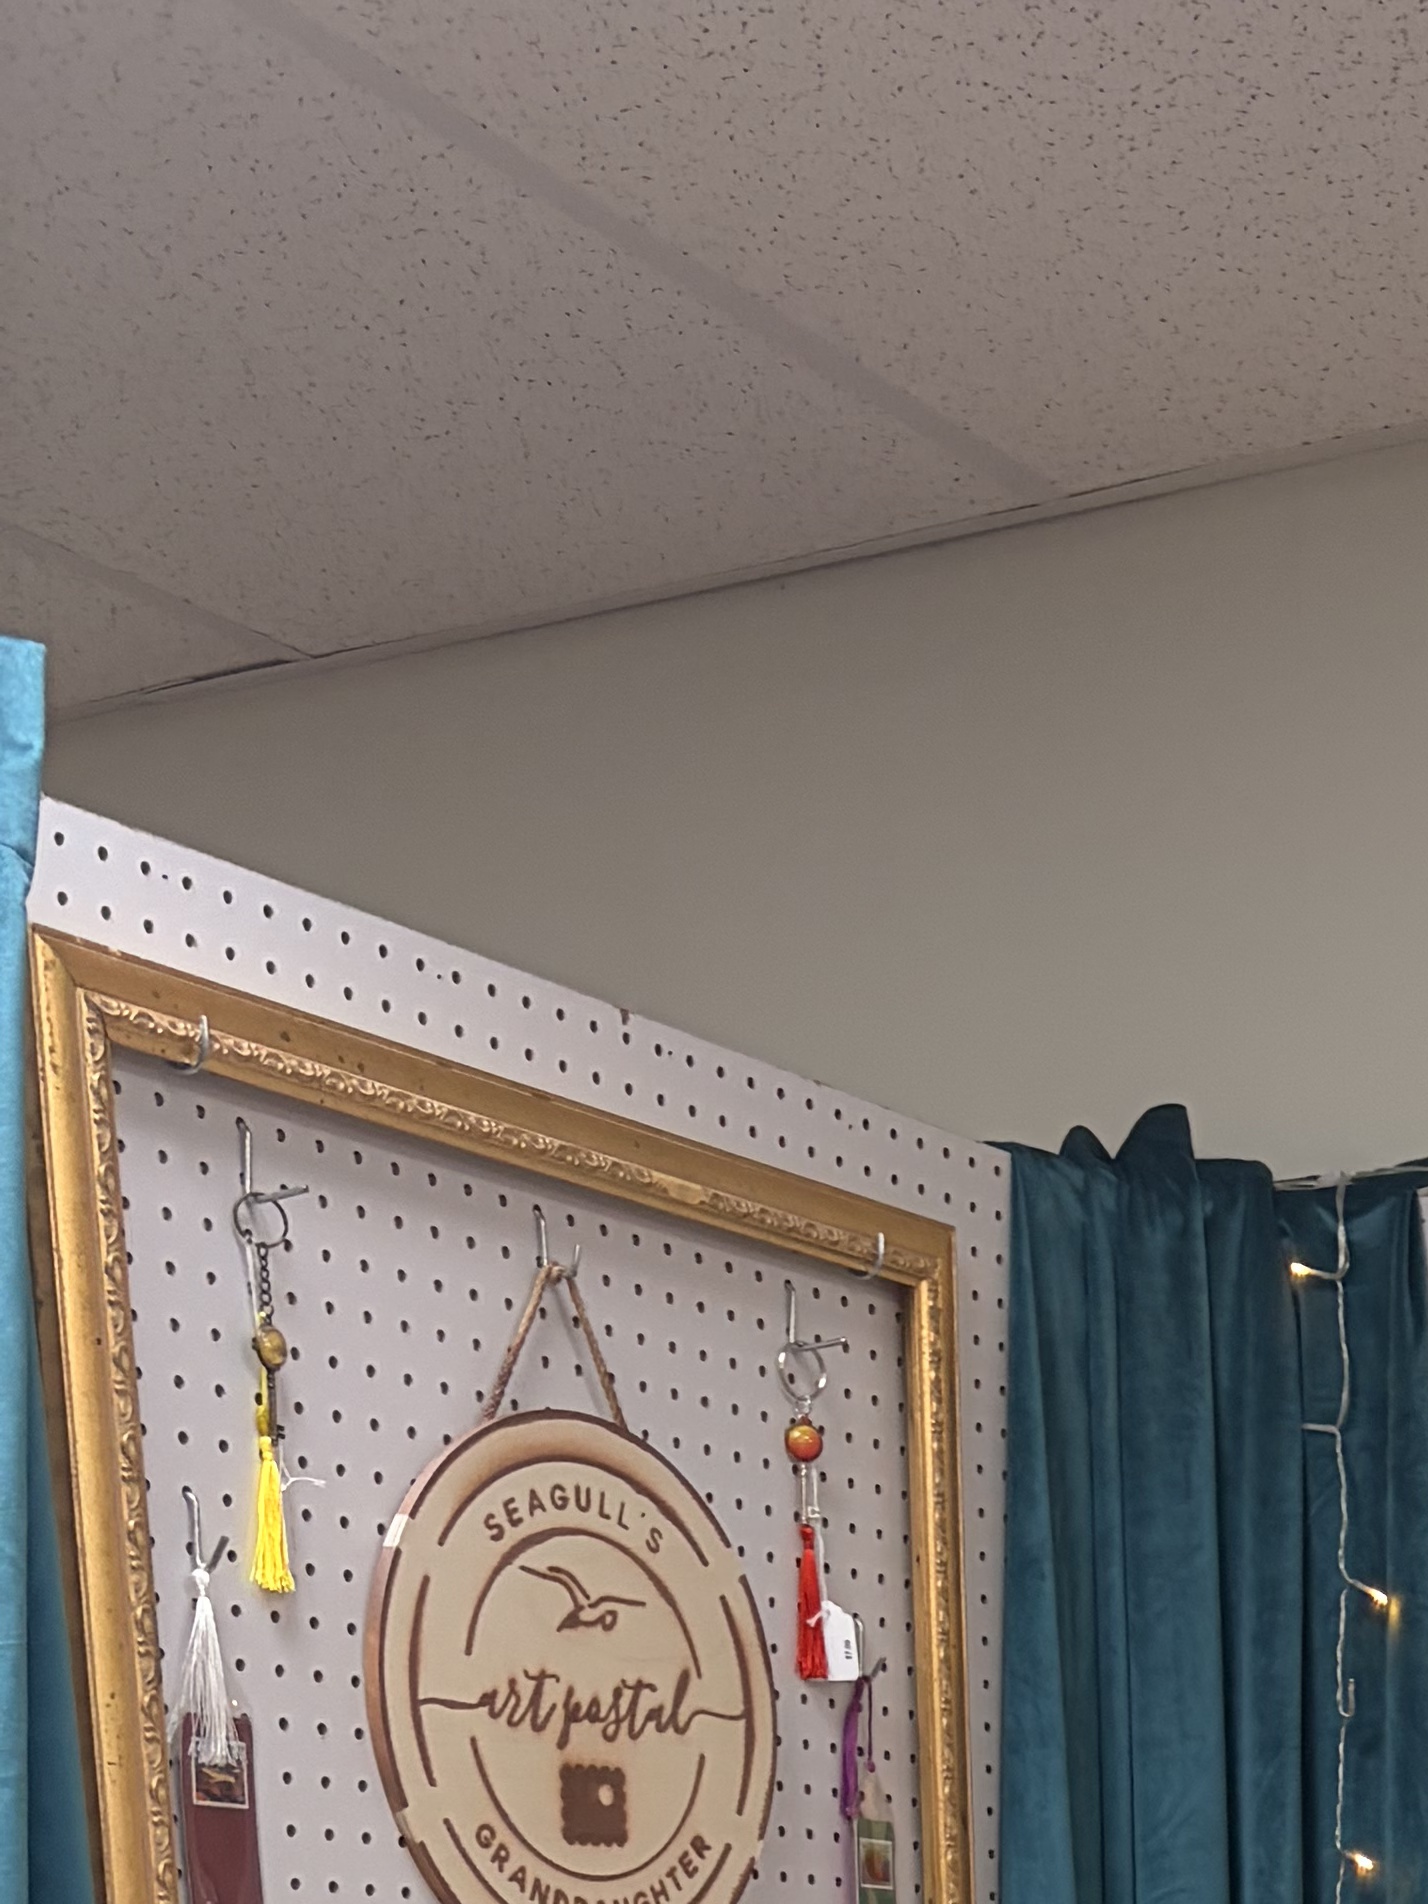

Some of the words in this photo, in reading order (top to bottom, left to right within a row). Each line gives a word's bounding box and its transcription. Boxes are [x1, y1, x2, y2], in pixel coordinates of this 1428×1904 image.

[483, 1482, 664, 1554] SEAGULL'S
[478, 1668, 559, 1733] art
[556, 1668, 696, 1750] postal
